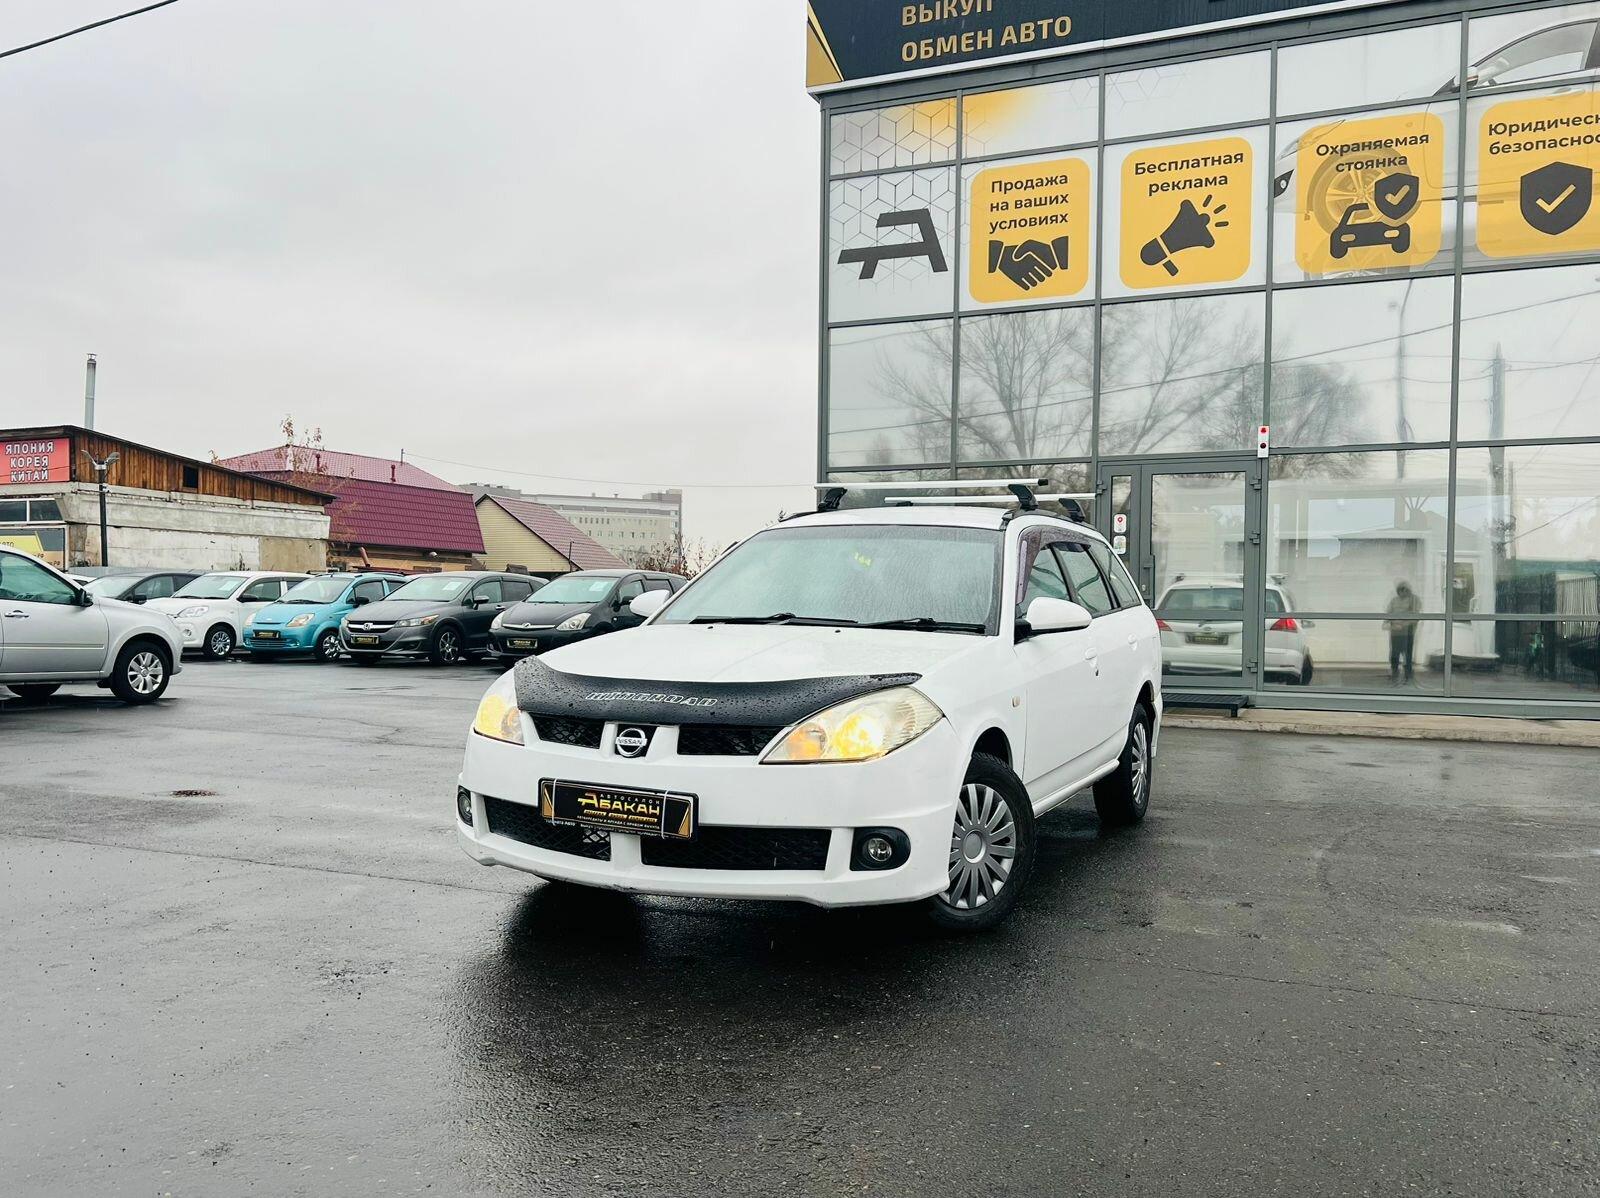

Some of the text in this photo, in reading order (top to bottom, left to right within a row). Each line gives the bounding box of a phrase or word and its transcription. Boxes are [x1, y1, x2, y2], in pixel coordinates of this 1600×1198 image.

[901, 16, 1072, 62] ОБМЕН АВТО
[1316, 134, 1429, 156] Охраняемая
[1135, 153, 1244, 175] Бесплатная
[1335, 155, 1408, 173] стоянка
[991, 174, 1068, 194] Продажа
[1148, 175, 1228, 197] реклама
[990, 193, 1069, 212] на ваших
[989, 213, 1069, 234] условиях
[5, 441, 54, 455] ЯПОНИЯ
[10, 455, 49, 468] КОРЕЯ
[11, 467, 48, 482] КИТАЙ
